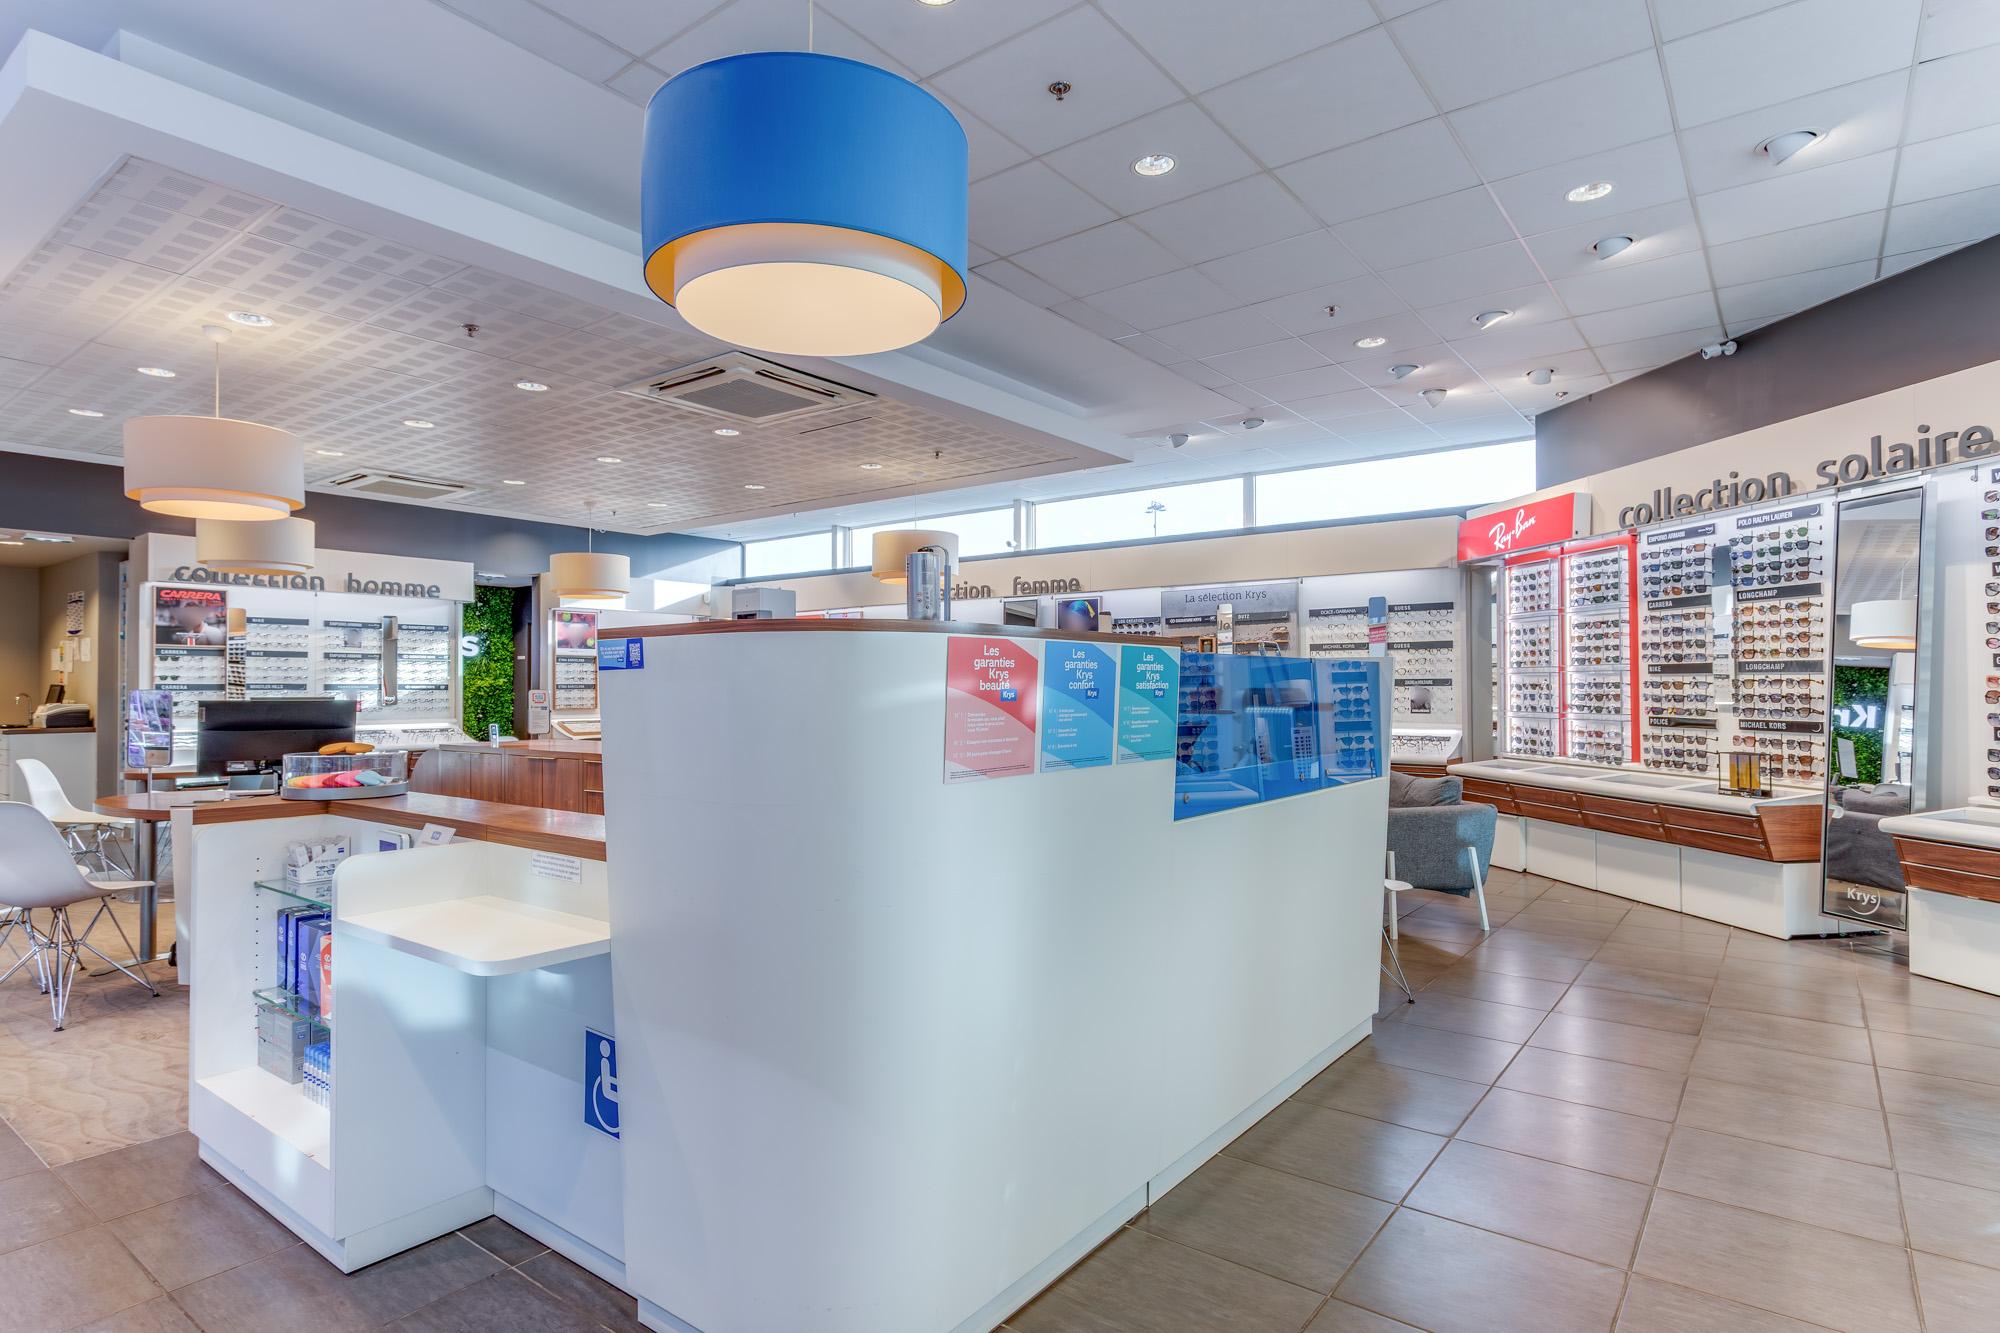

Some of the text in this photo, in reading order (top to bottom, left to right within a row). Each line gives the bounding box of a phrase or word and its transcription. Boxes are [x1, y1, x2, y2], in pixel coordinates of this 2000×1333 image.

[1619, 424, 1994, 529] collection solaire
[1737, 510, 1793, 527] POLO RALPH LAUREN
[347, 572, 441, 599] homme
[1012, 575, 1081, 596] femme
[160, 589, 221, 601] CARRERA
[1185, 590, 1267, 604] La sélection Krys
[1738, 589, 1777, 600] LONGCHAMP
[1648, 600, 1672, 609] CARRERA
[983, 644, 1000, 656] Les
[1072, 648, 1086, 659] Les
[1143, 652, 1154, 661] Les
[973, 657, 1015, 670] garanties
[1064, 659, 1098, 671] garanties
[1136, 661, 1164, 673] garanties
[1649, 665, 1662, 673] NIKE
[1745, 662, 1785, 671] LONGCHAMP
[988, 668, 1009, 681] Krys
[1076, 669, 1093, 682] Krys
[1146, 671, 1160, 682] Krys
[979, 679, 1010, 691] beauté
[1068, 680, 1095, 690] confort
[1136, 680, 1169, 690] satisfaction
[1002, 690, 1015, 699] Krys
[1087, 689, 1097, 698] Krys
[1649, 718, 1669, 726] POLICE
[1740, 721, 1787, 730] MICHAEL KORS
[1847, 887, 1877, 906] Krys
